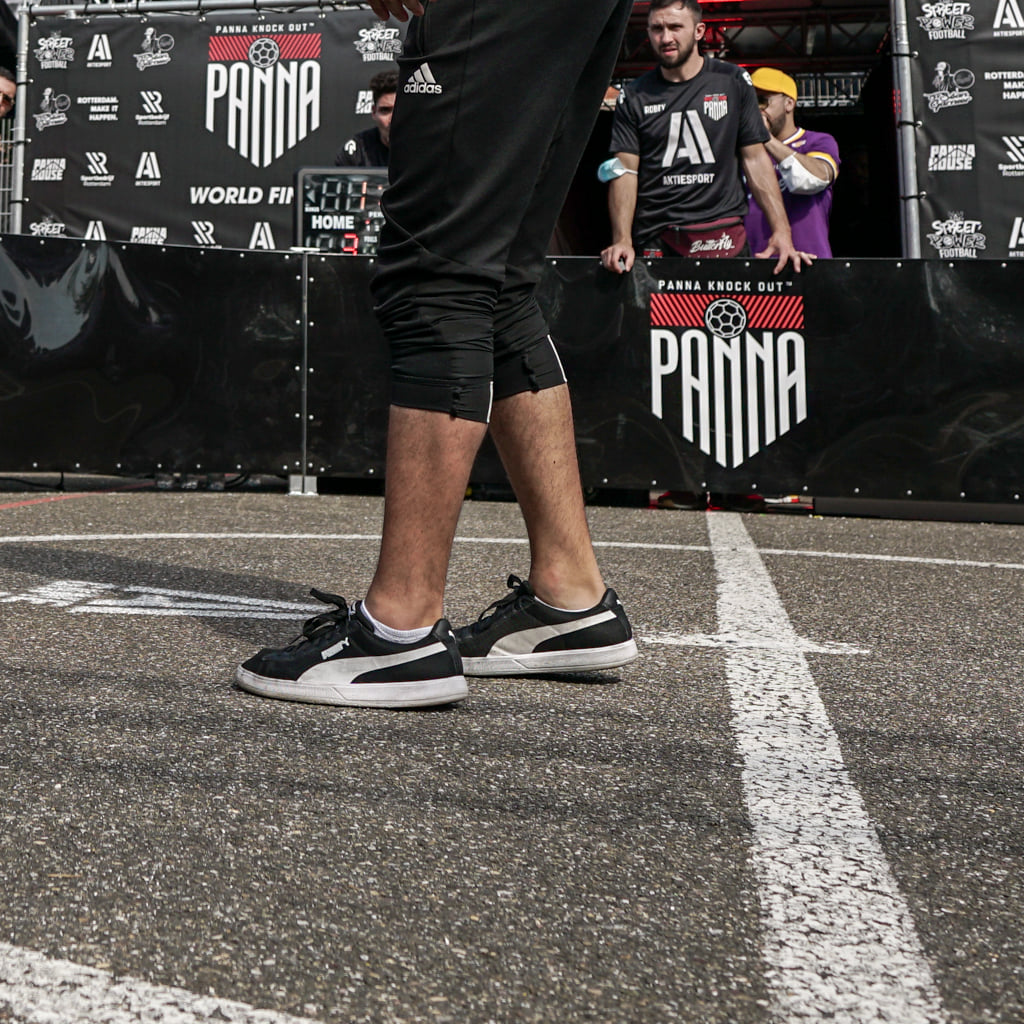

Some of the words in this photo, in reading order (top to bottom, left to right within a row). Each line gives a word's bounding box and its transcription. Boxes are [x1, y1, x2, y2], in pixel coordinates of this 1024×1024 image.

[216, 26, 248, 34] PANNA
[252, 24, 284, 32] KNOCK
[928, 29, 966, 40] FOOTBALL
[362, 53, 394, 62] FOOTBALL
[984, 72, 1024, 80] ROTTERD
[404, 81, 442, 94] adidas
[205, 59, 321, 168] PANNA
[932, 144, 976, 159] PANNA
[927, 157, 973, 171] HOUSE
[663, 173, 715, 186] AKTIESPORT
[190, 186, 264, 205] WORLD
[311, 215, 355, 229] HOME
[939, 249, 977, 259] FOOTBALL
[658, 280, 702, 291] PANNA
[708, 280, 751, 292] KNOCK
[650, 329, 808, 469] PANNA
